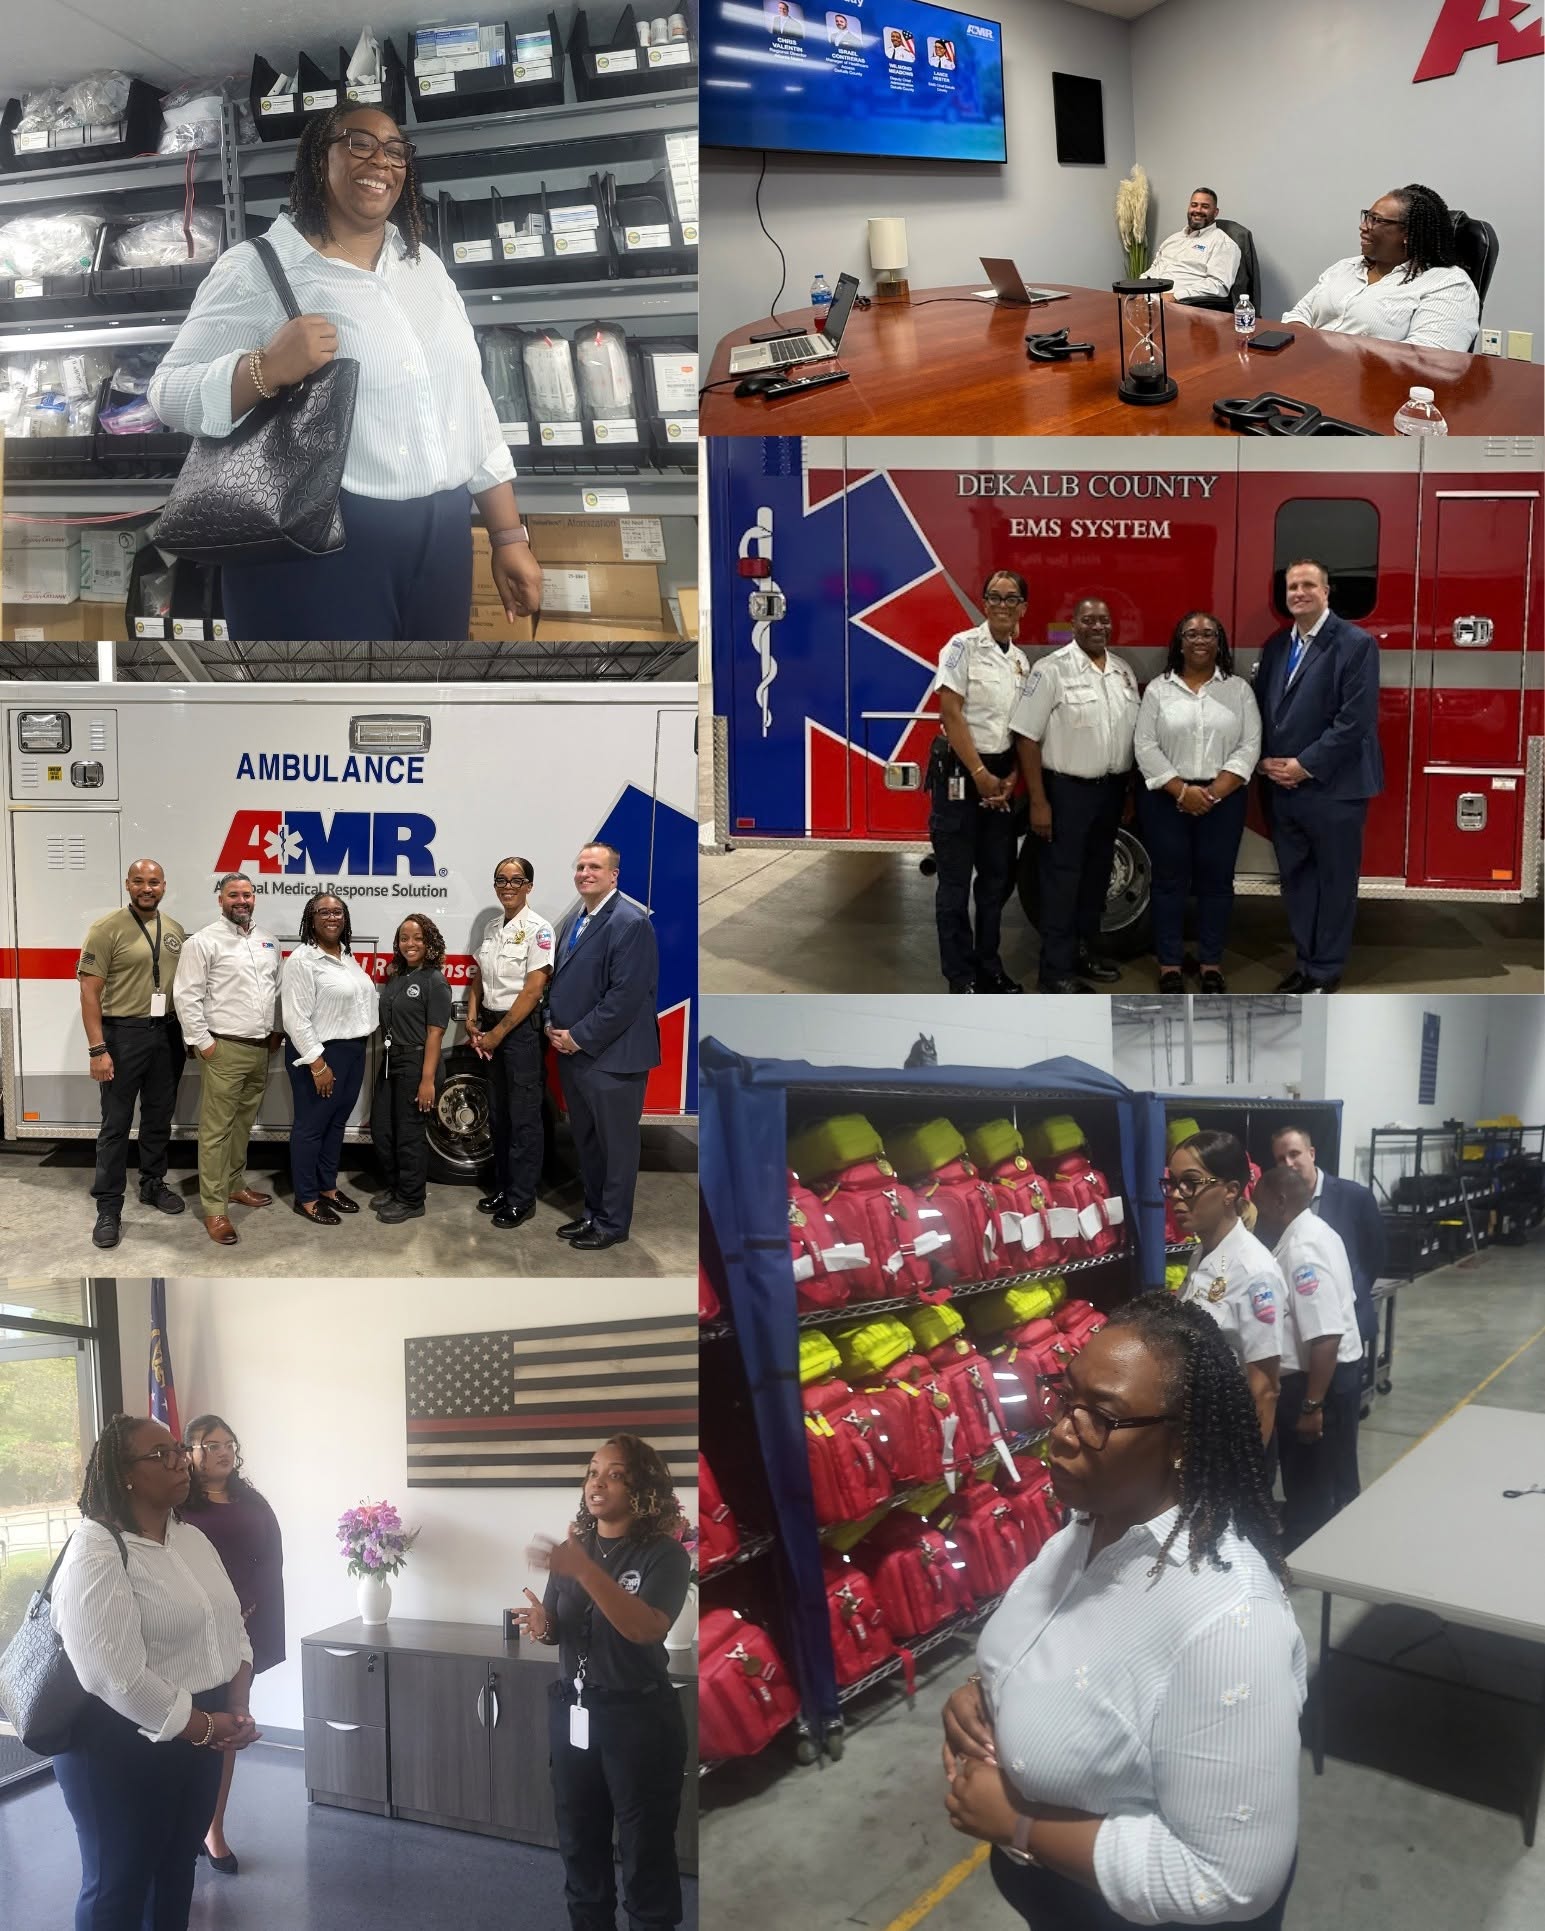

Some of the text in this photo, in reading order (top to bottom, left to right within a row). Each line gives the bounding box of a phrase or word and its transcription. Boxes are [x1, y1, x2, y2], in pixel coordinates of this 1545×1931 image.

[967, 24, 993, 39] AMR
[772, 42, 803, 53] VALENTIN
[777, 37, 797, 46] CHRIS
[831, 53, 866, 64] CONTRERAS
[838, 48, 859, 57] ISRAEL
[957, 473, 1219, 498] DEKALB COUNTY
[1009, 518, 1171, 539] EMS SYSTEM
[236, 753, 424, 784] AMBULANCE
[272, 882, 322, 895] Medical
[326, 882, 389, 899] Response
[391, 883, 448, 898] Solution
